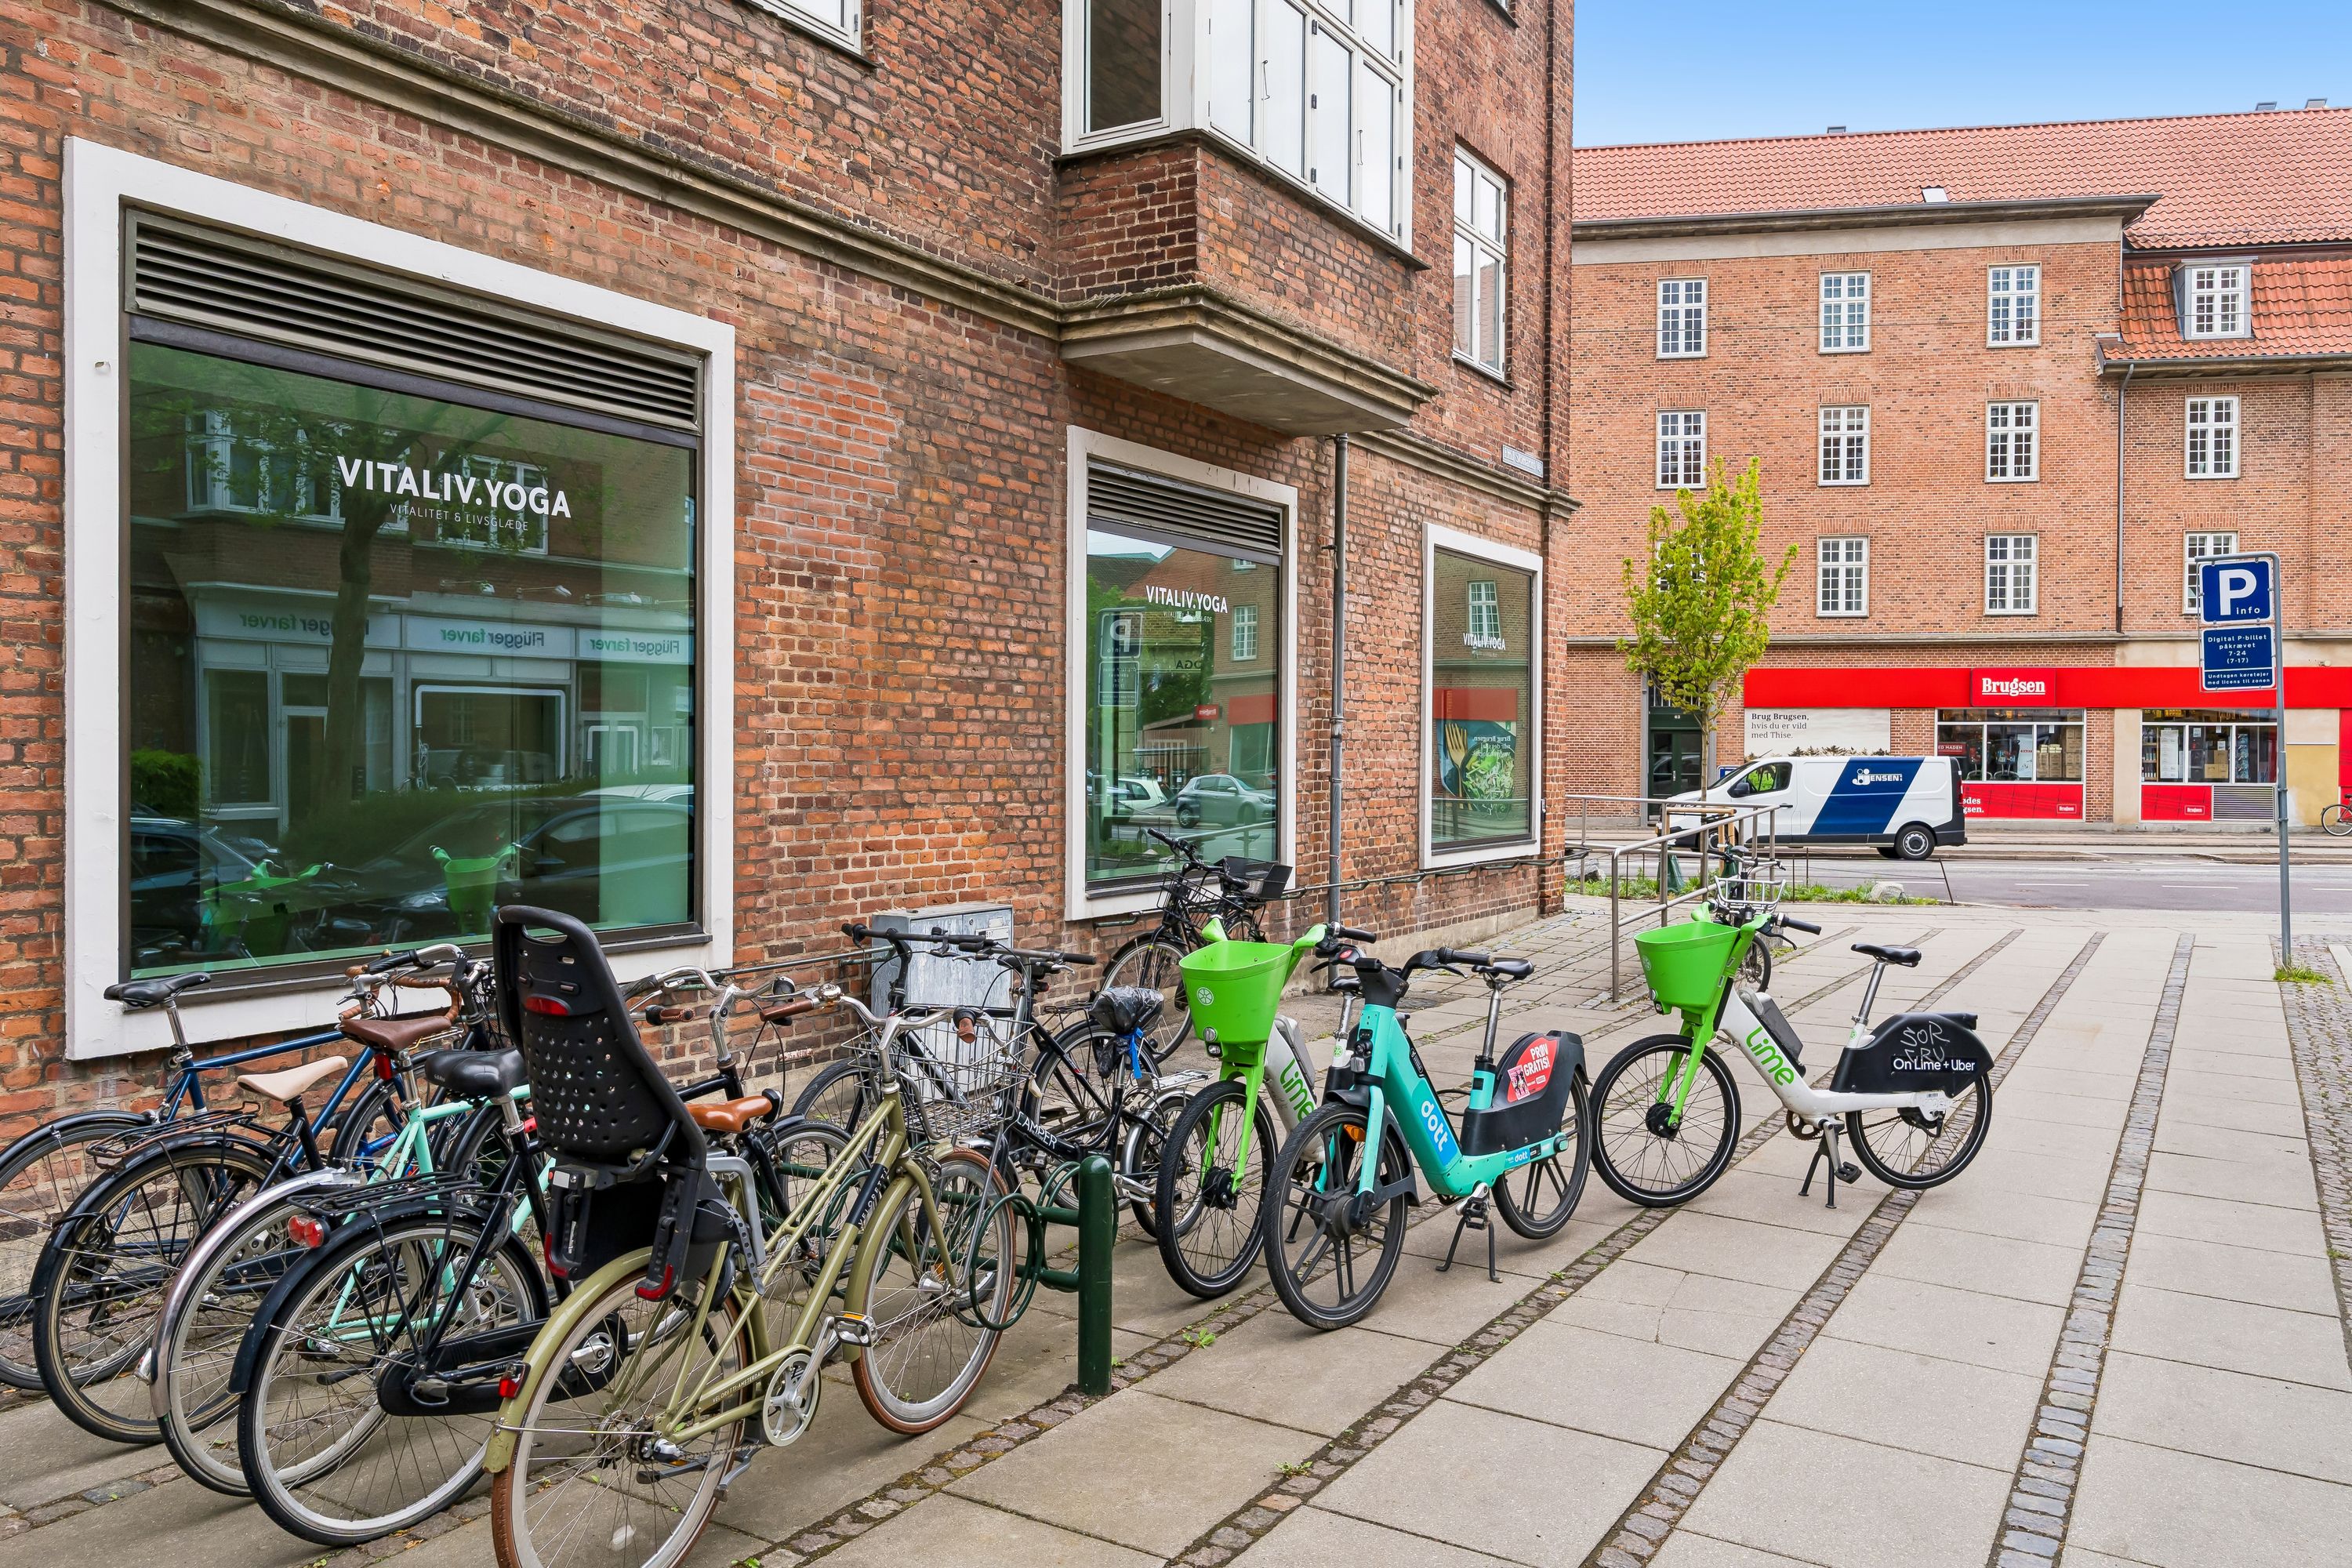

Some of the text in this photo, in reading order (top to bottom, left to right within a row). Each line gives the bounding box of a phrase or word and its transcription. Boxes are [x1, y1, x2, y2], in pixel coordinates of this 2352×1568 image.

[336, 456, 572, 518] VITALIV.YOGA
[390, 503, 528, 532] VITALITET & LIVSGLÆDE
[1145, 585, 1229, 615] VITALIV.YOGA
[2219, 568, 2260, 615] P info
[1463, 633, 1506, 651] VITALIV.YOGA
[1981, 677, 2045, 697] Brugsen
[1751, 713, 1809, 721] Brug Brugsen,
[1523, 1056, 1551, 1076] GRATIS!
[1530, 1043, 1549, 1061] PRØV
[1745, 1026, 1795, 1087] Lime
[1893, 1058, 1911, 1070] On
[1914, 1058, 1941, 1070] Lime
[1951, 1059, 1976, 1071] Uber
[1279, 1058, 1315, 1123] Lime
[1016, 1111, 1058, 1149] CAMPER
[1421, 1100, 1449, 1152] dott
[1514, 1151, 1528, 1163] dott
